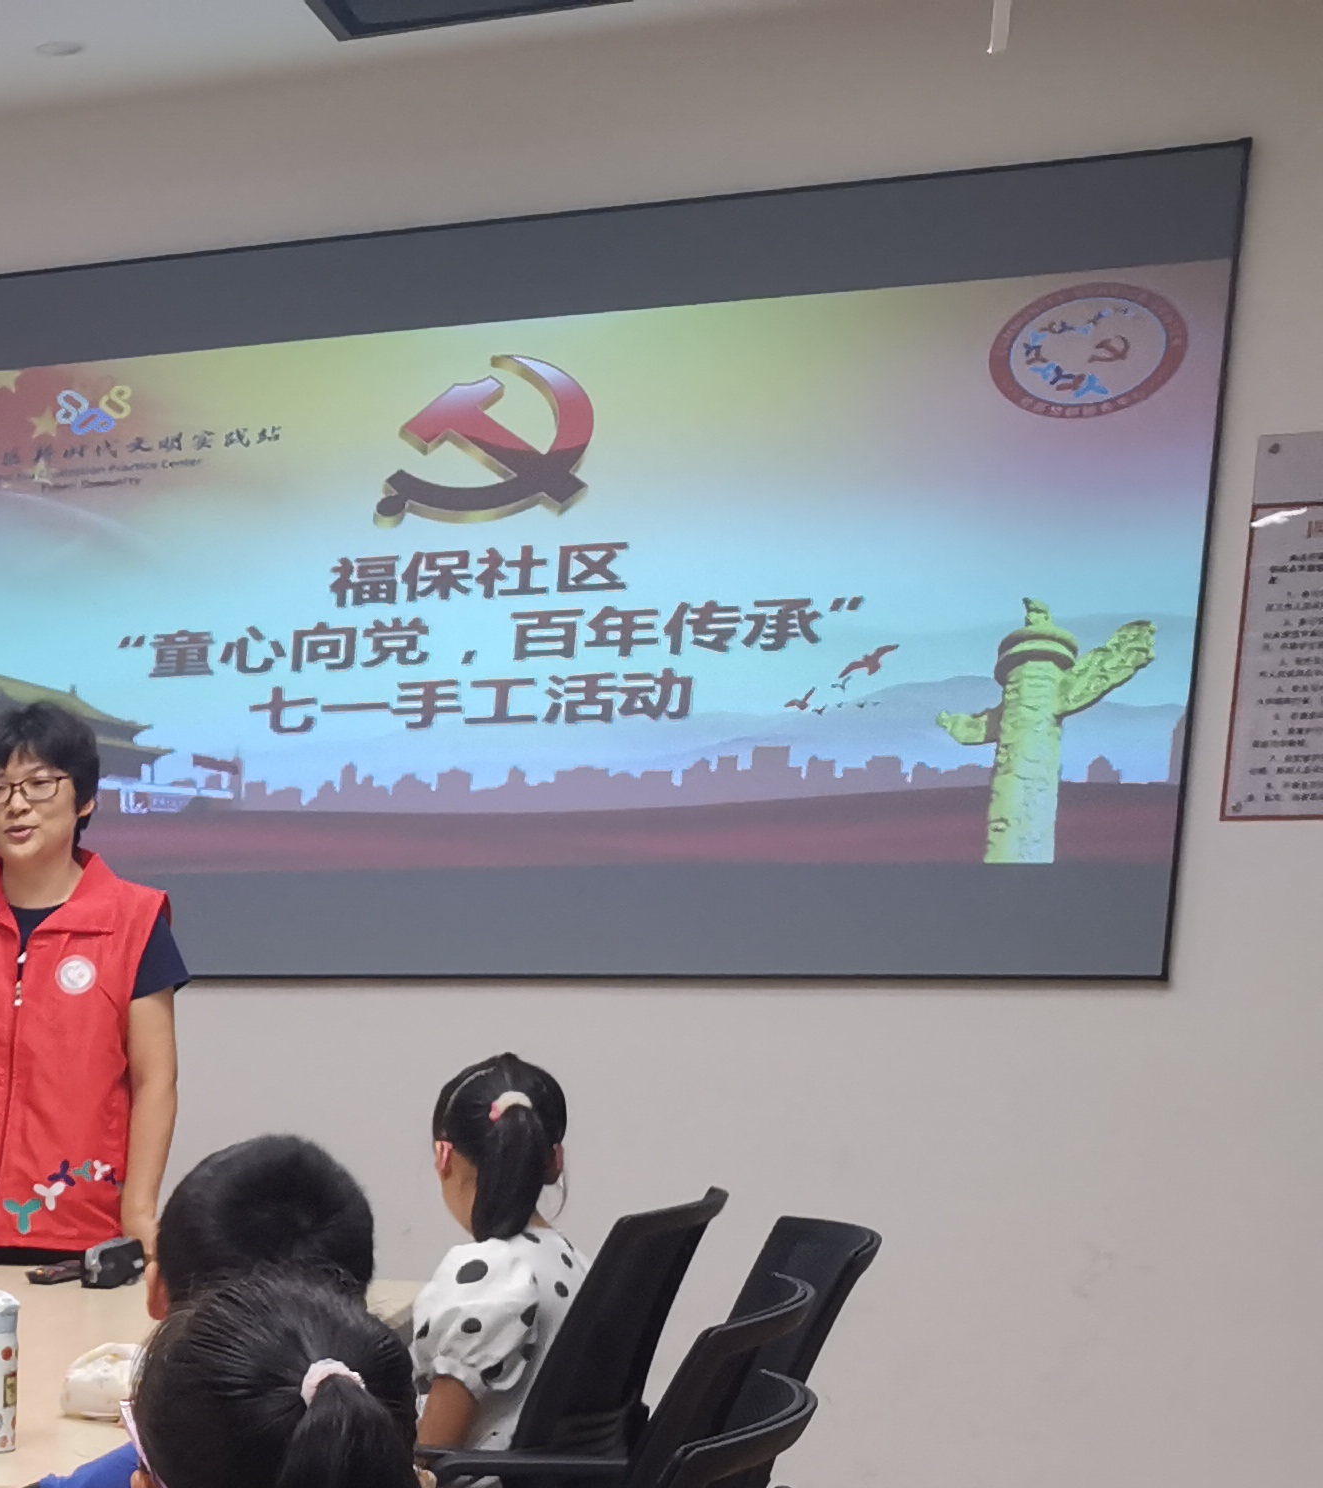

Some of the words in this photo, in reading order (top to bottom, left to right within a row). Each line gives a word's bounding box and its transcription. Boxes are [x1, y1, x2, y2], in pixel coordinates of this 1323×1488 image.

[328, 540, 631, 609] 福保社区
[248, 670, 694, 736] 七一手工活动
